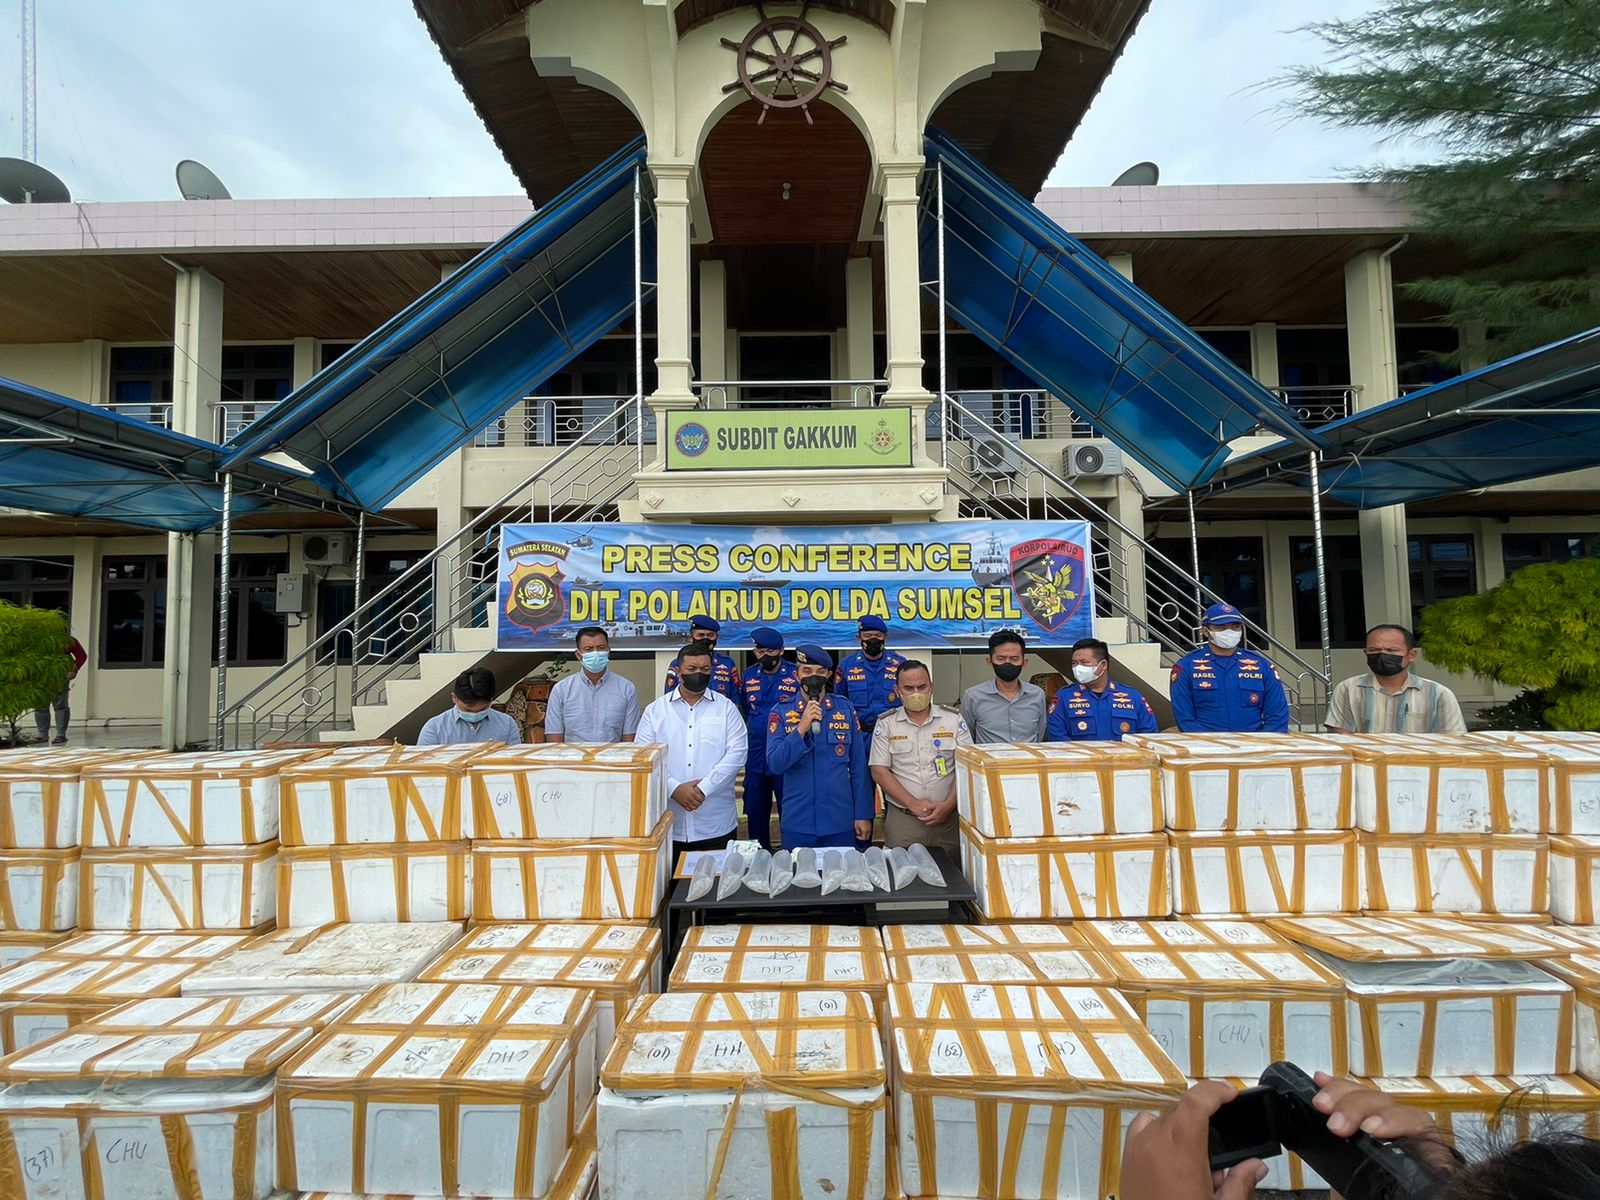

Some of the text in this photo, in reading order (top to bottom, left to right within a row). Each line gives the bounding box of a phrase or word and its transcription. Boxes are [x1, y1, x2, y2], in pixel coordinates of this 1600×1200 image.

[717, 427, 778, 450] SUBDIT
[784, 426, 857, 449] GAKKUM
[509, 544, 566, 556] SUMATERA SELATAN
[602, 542, 972, 573] PRESS CONFERENCE
[1017, 543, 1078, 555] KORPOLAIRUD
[570, 586, 1022, 622] DIT POLAIRUD POLDA SUMSEL
[829, 722, 849, 730] POLRI
[1219, 1024, 1250, 1044] CHU
[488, 1050, 529, 1064] CHU
[24, 1138, 148, 1181] (37) CHU
